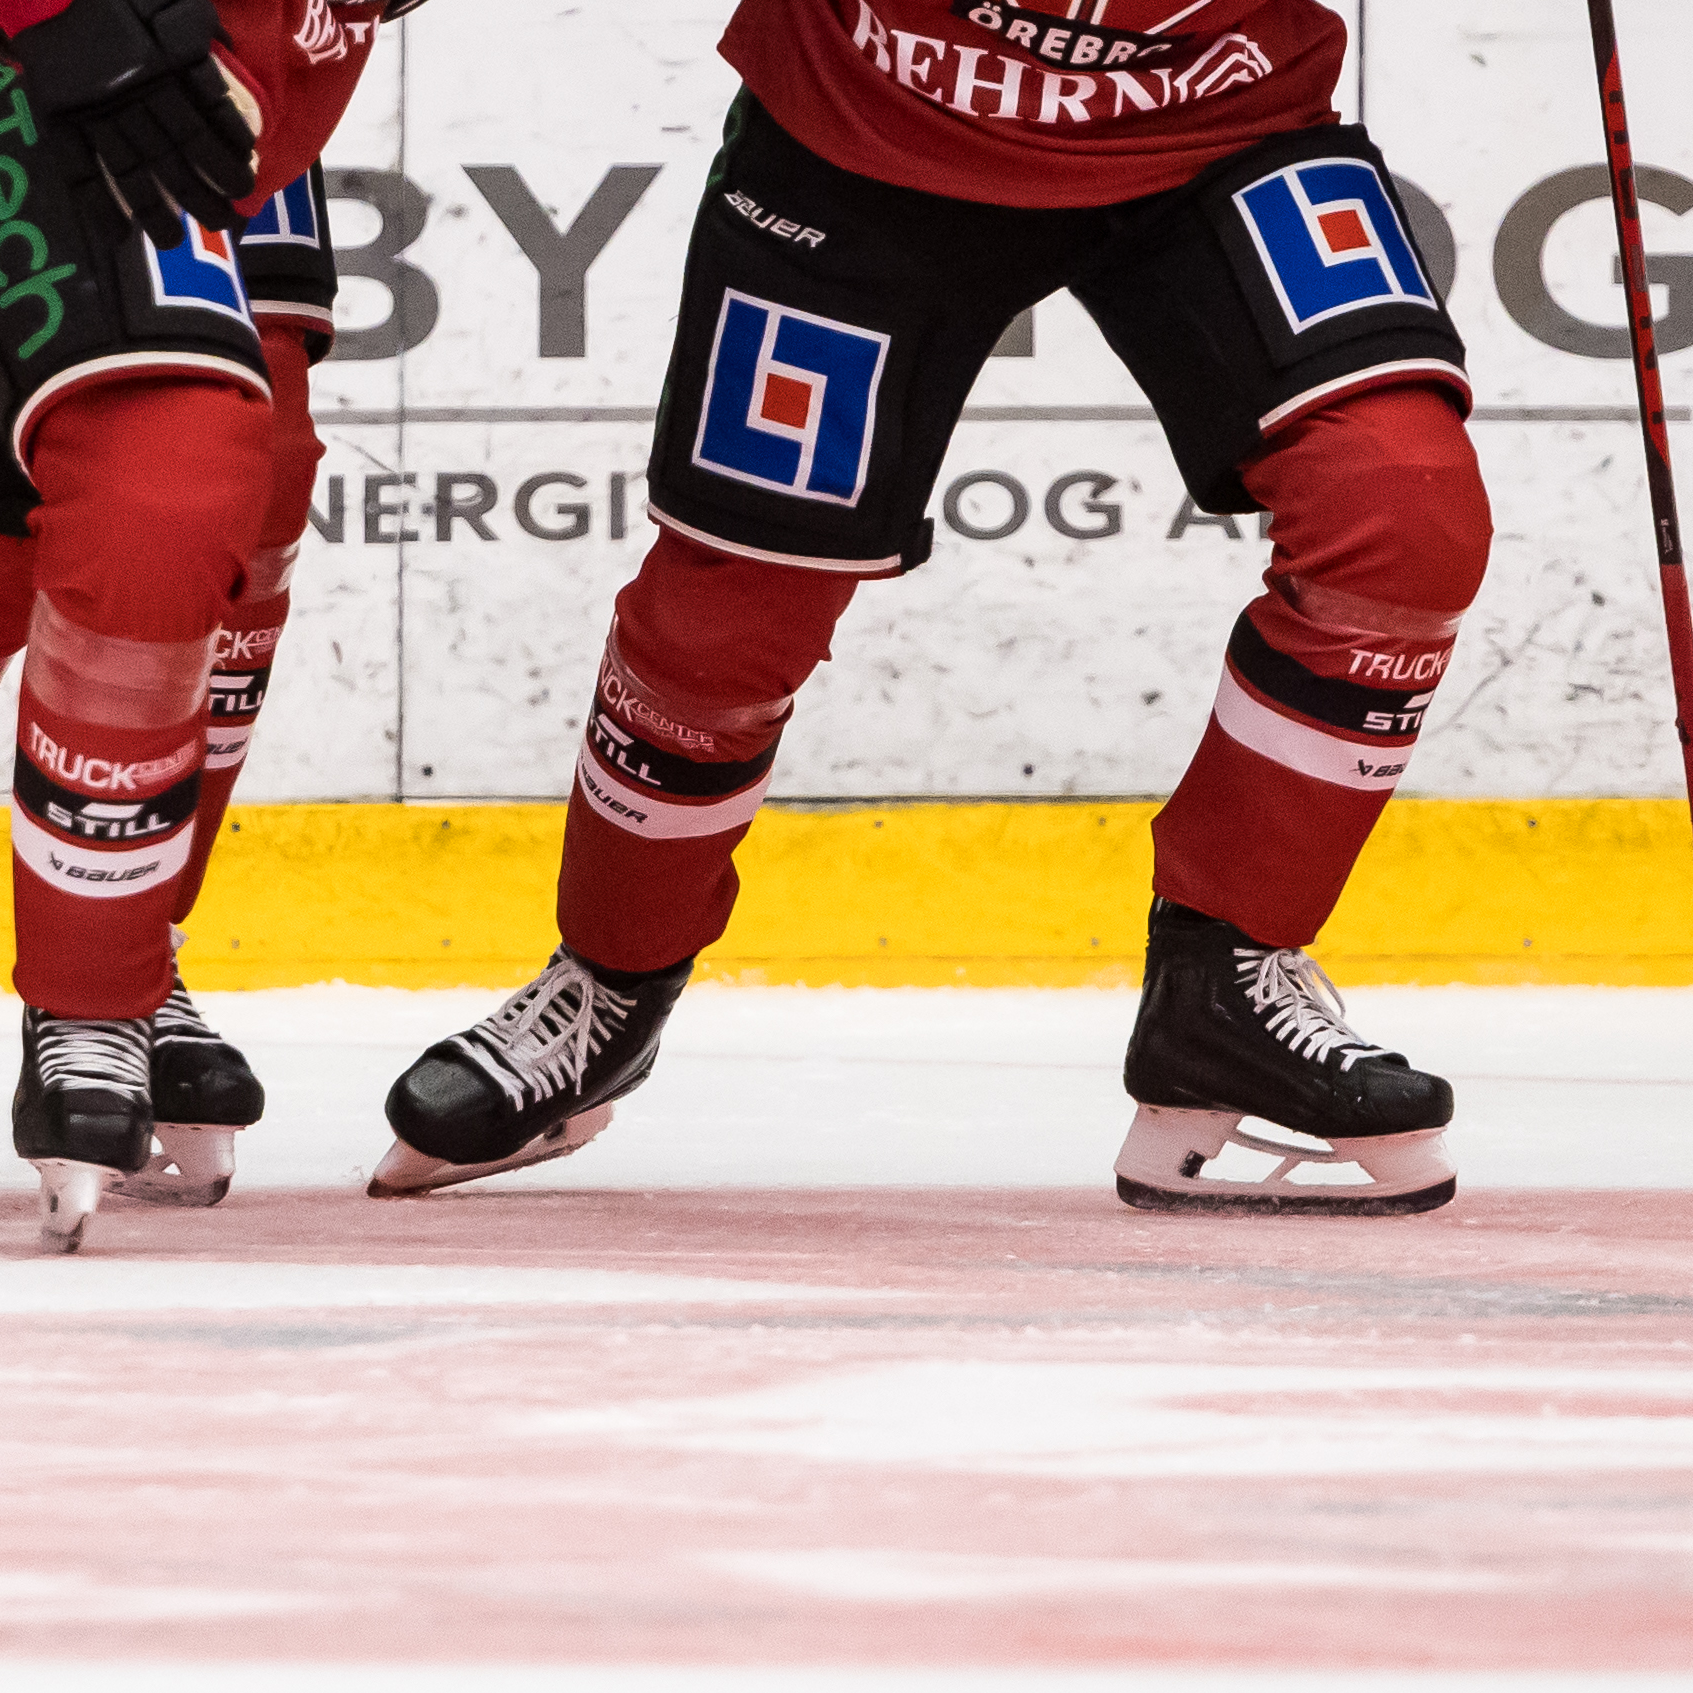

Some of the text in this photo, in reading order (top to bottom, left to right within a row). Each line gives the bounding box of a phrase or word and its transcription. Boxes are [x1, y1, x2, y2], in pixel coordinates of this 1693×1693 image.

[723, 189, 827, 248] BAUER
[29, 719, 139, 791] TRUCK
[45, 801, 173, 840] STILL
[65, 859, 161, 883] BAUER
